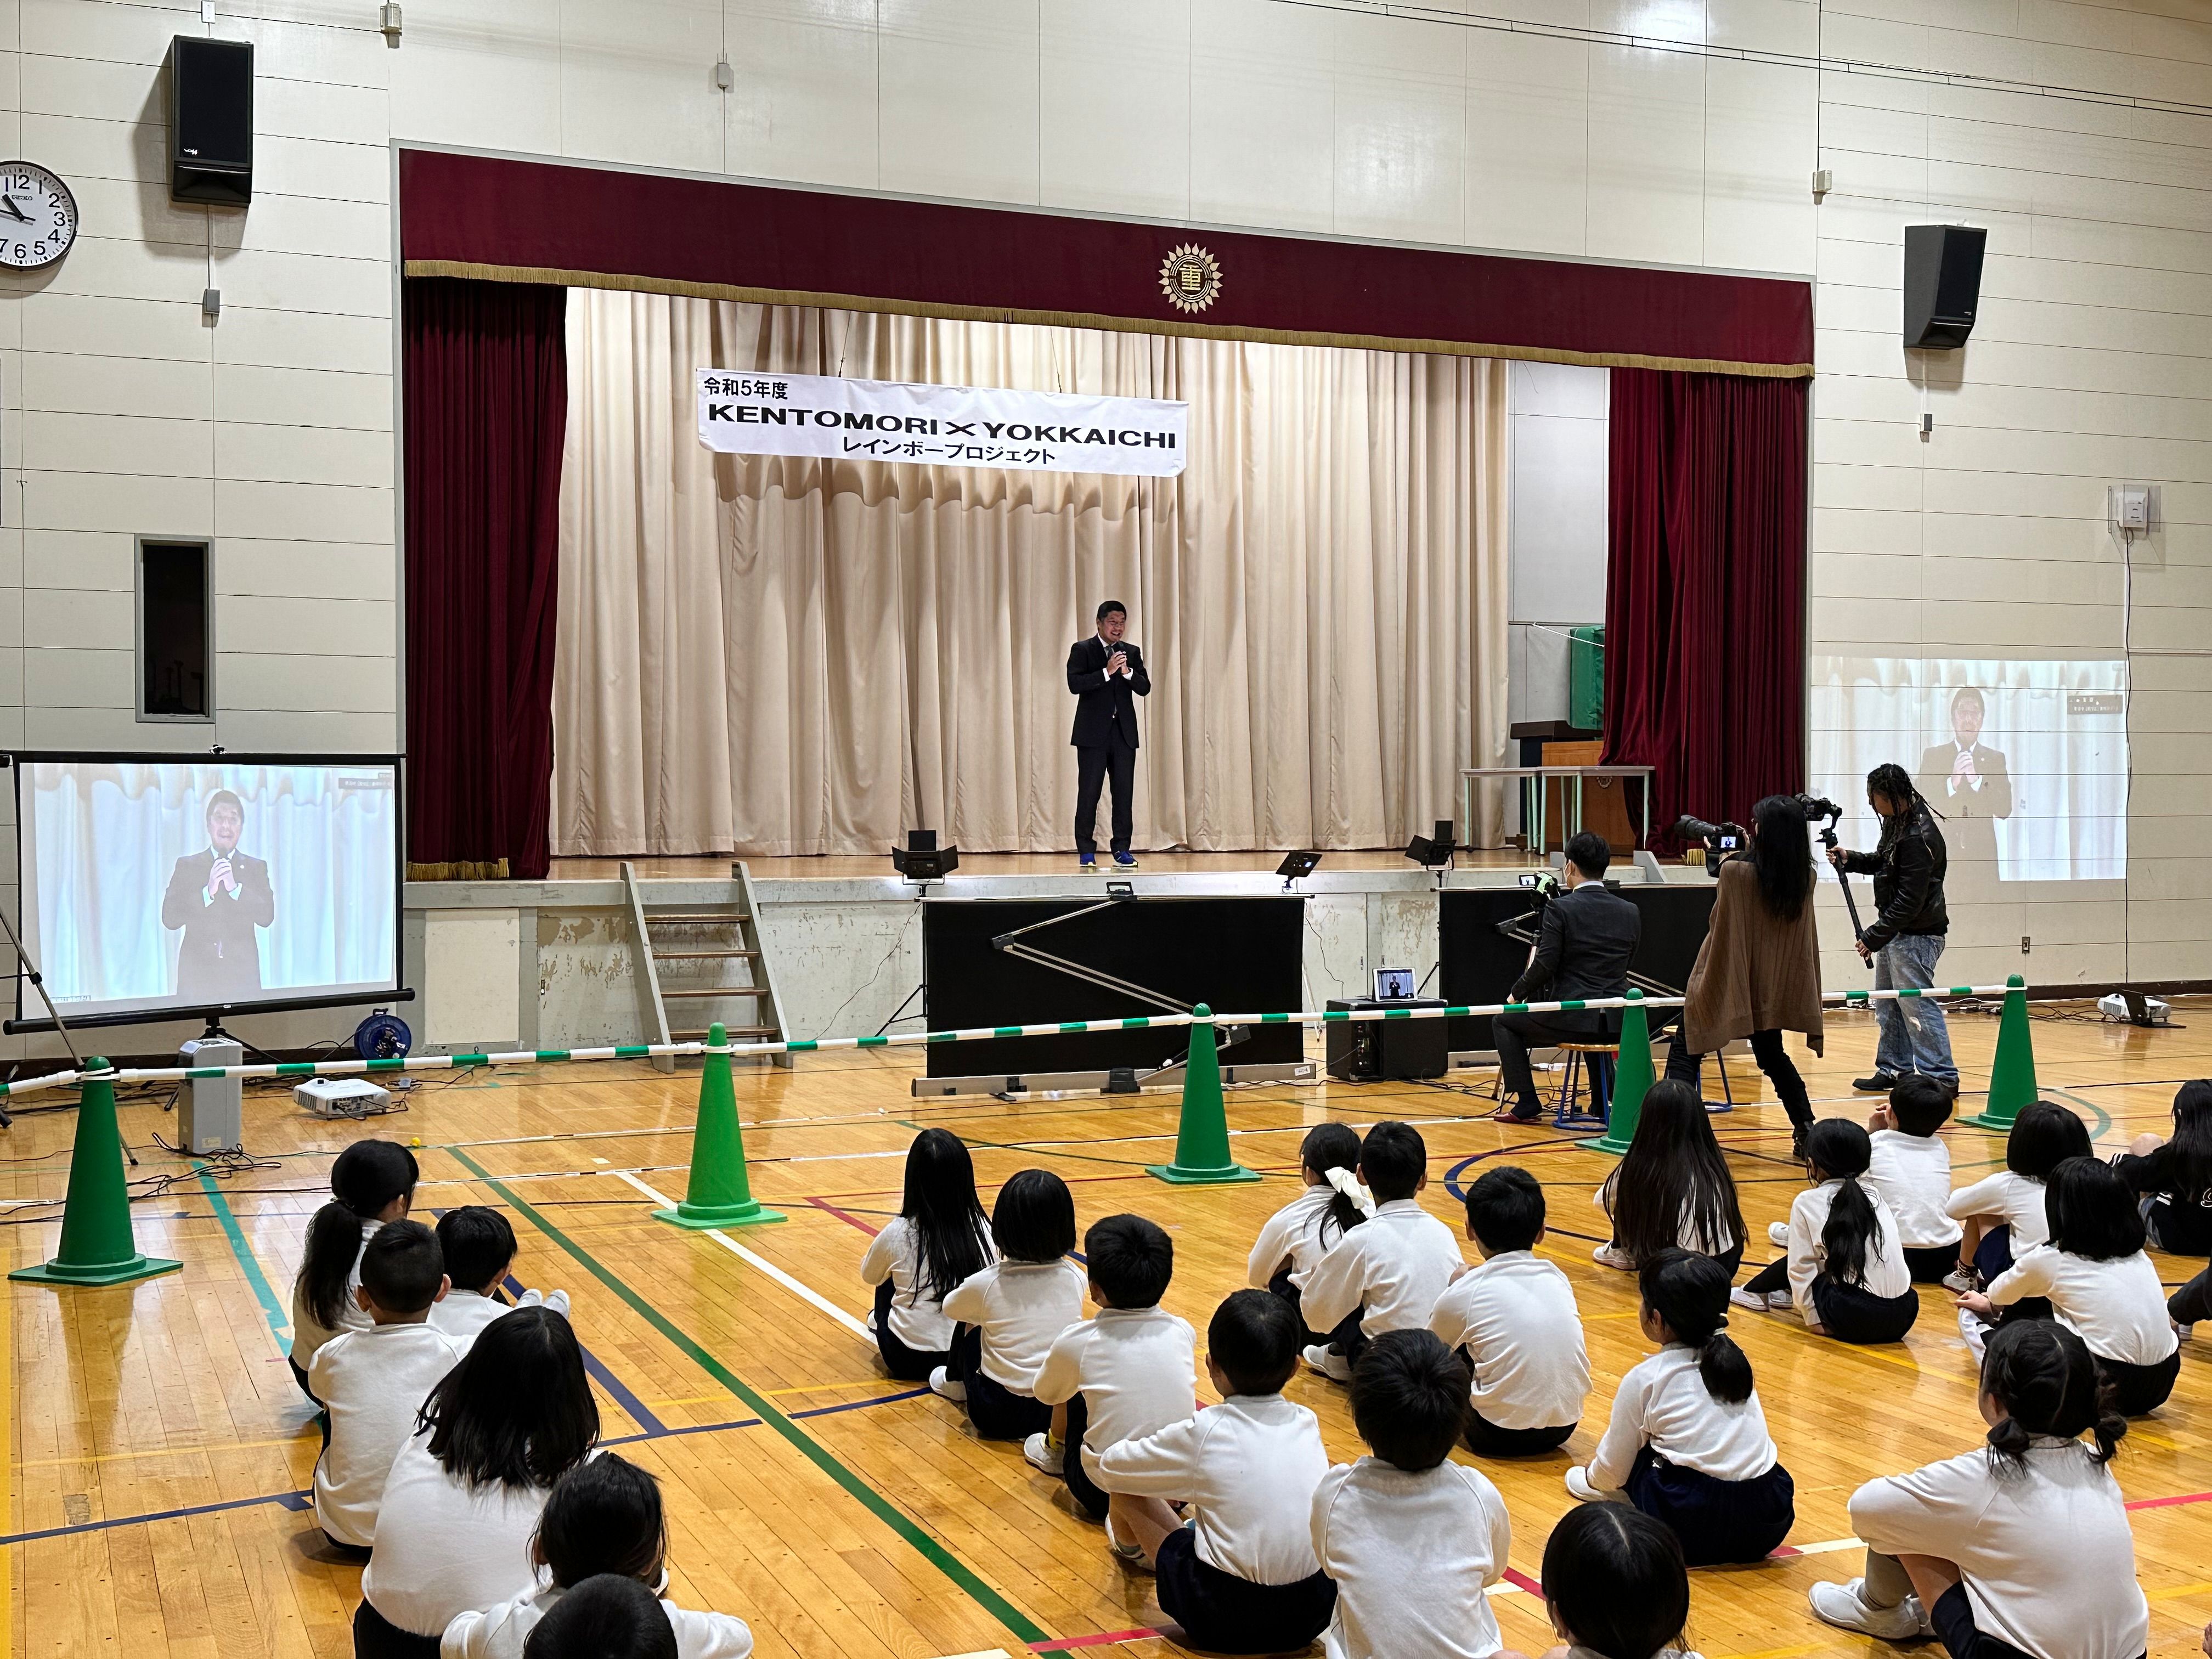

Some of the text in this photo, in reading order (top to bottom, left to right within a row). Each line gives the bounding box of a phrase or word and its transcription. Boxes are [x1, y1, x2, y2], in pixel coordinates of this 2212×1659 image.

[14, 174, 30, 190] 12
[39, 179, 42, 195] 1
[48, 193, 60, 208] 2
[53, 211, 66, 227] 3
[47, 229, 60, 244] 4
[14, 244, 26, 259] 6
[33, 240, 46, 256] 5
[704, 377, 788, 400] 令和5年度
[843, 437, 1056, 465] レインボープロジェクト
